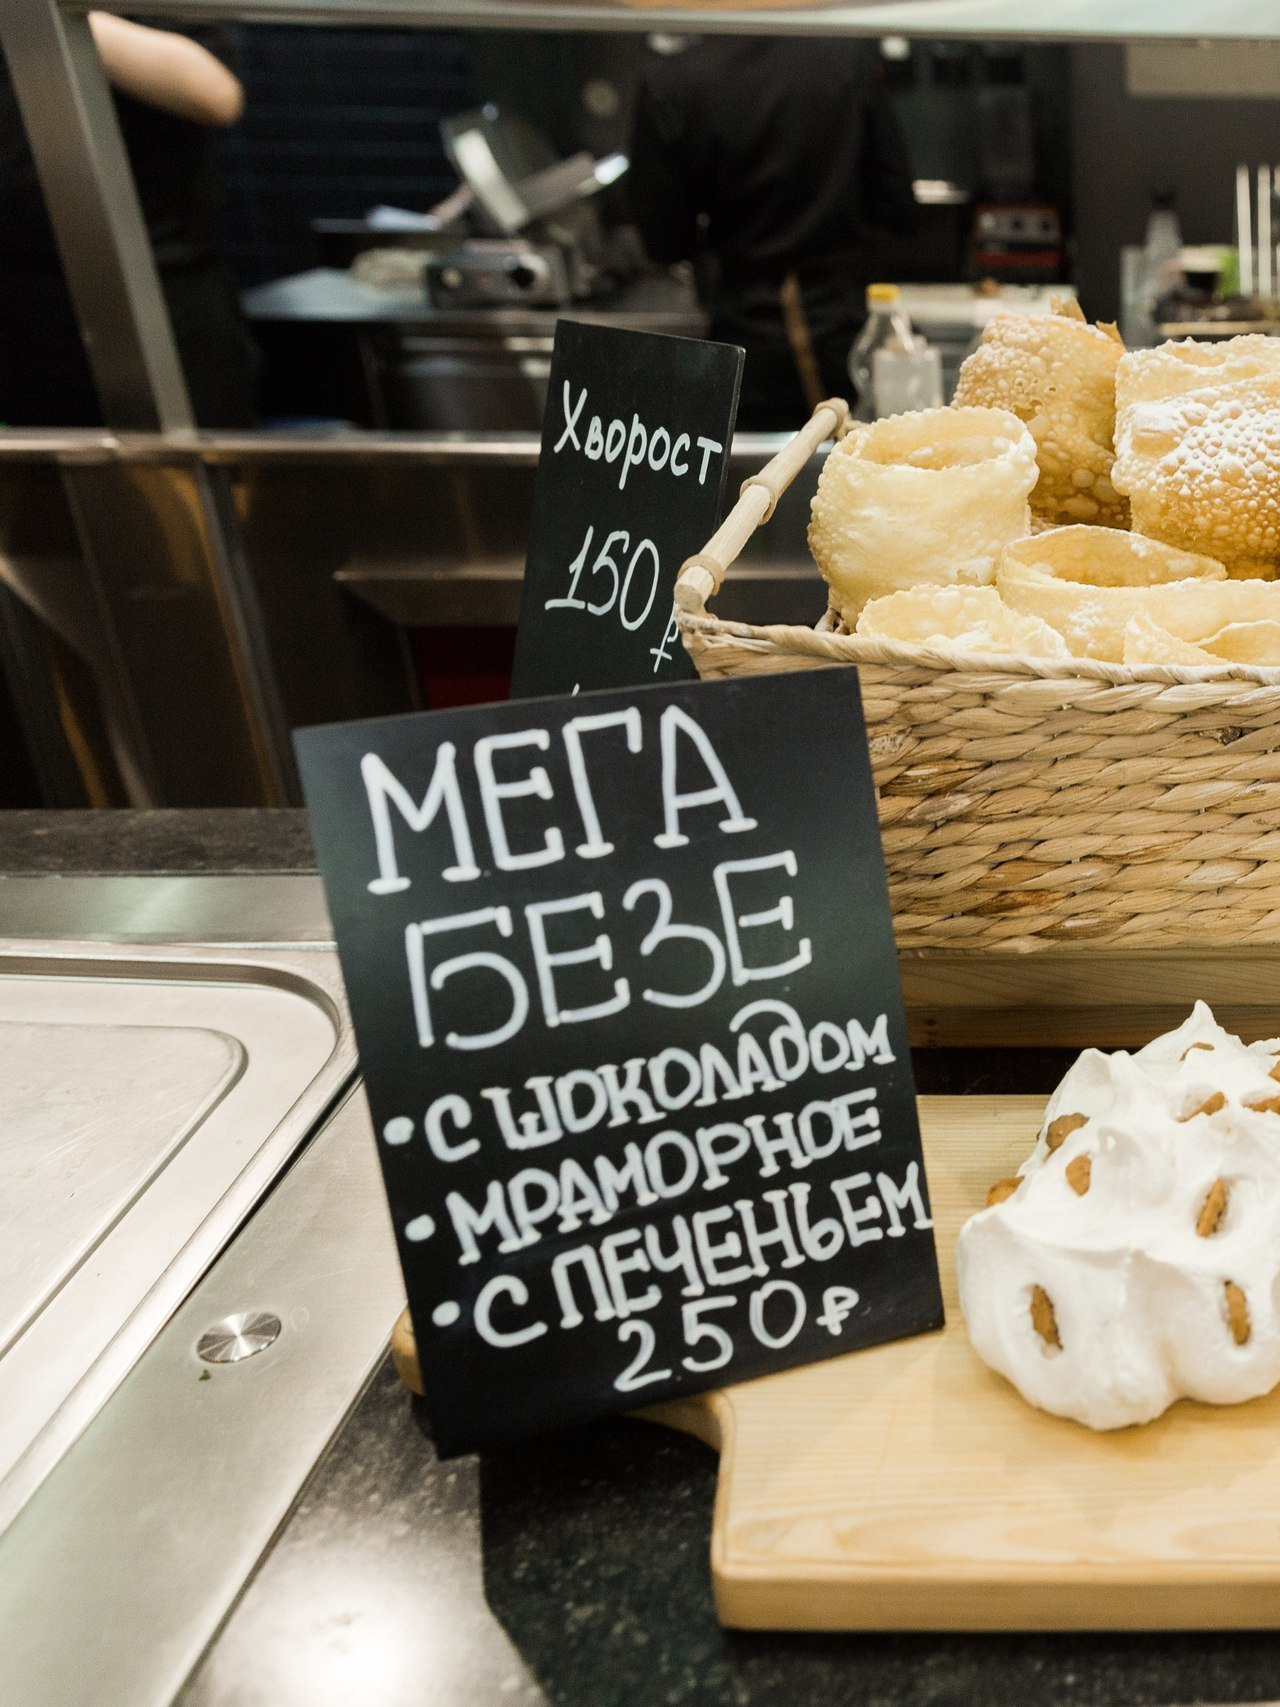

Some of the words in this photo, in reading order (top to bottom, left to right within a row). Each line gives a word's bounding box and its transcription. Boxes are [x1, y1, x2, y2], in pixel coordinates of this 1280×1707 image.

[554, 380, 723, 490] Хворост
[361, 704, 758, 896] МЕГА
[405, 850, 813, 1050] БЕЗЕ
[445, 1087, 883, 1266] МРАМОРНОЕ
[551, 1161, 935, 1330] ПЕЧЕНЬЕМ
